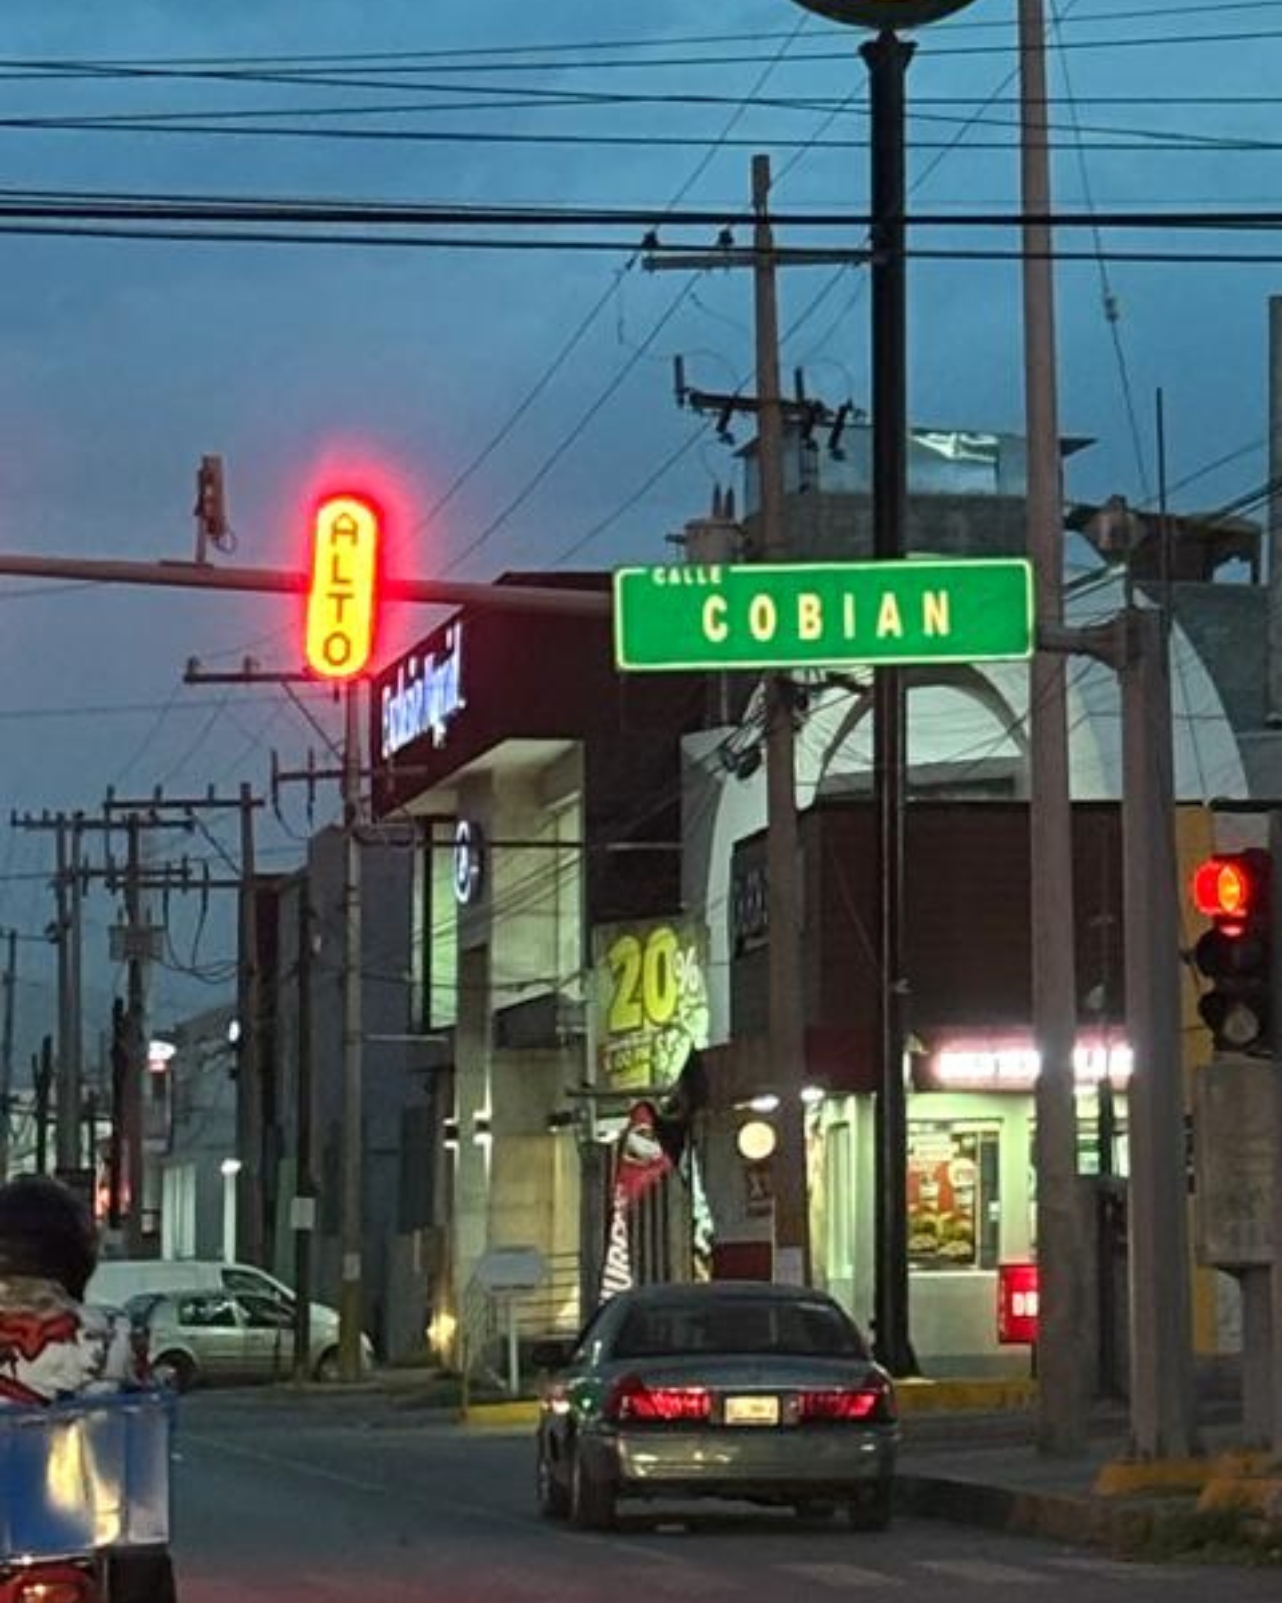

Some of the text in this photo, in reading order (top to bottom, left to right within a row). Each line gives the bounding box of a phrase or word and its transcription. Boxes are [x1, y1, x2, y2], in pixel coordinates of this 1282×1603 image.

[322, 511, 360, 667] ALTO
[653, 566, 722, 585] CALLE
[702, 589, 951, 643] COBIAN
